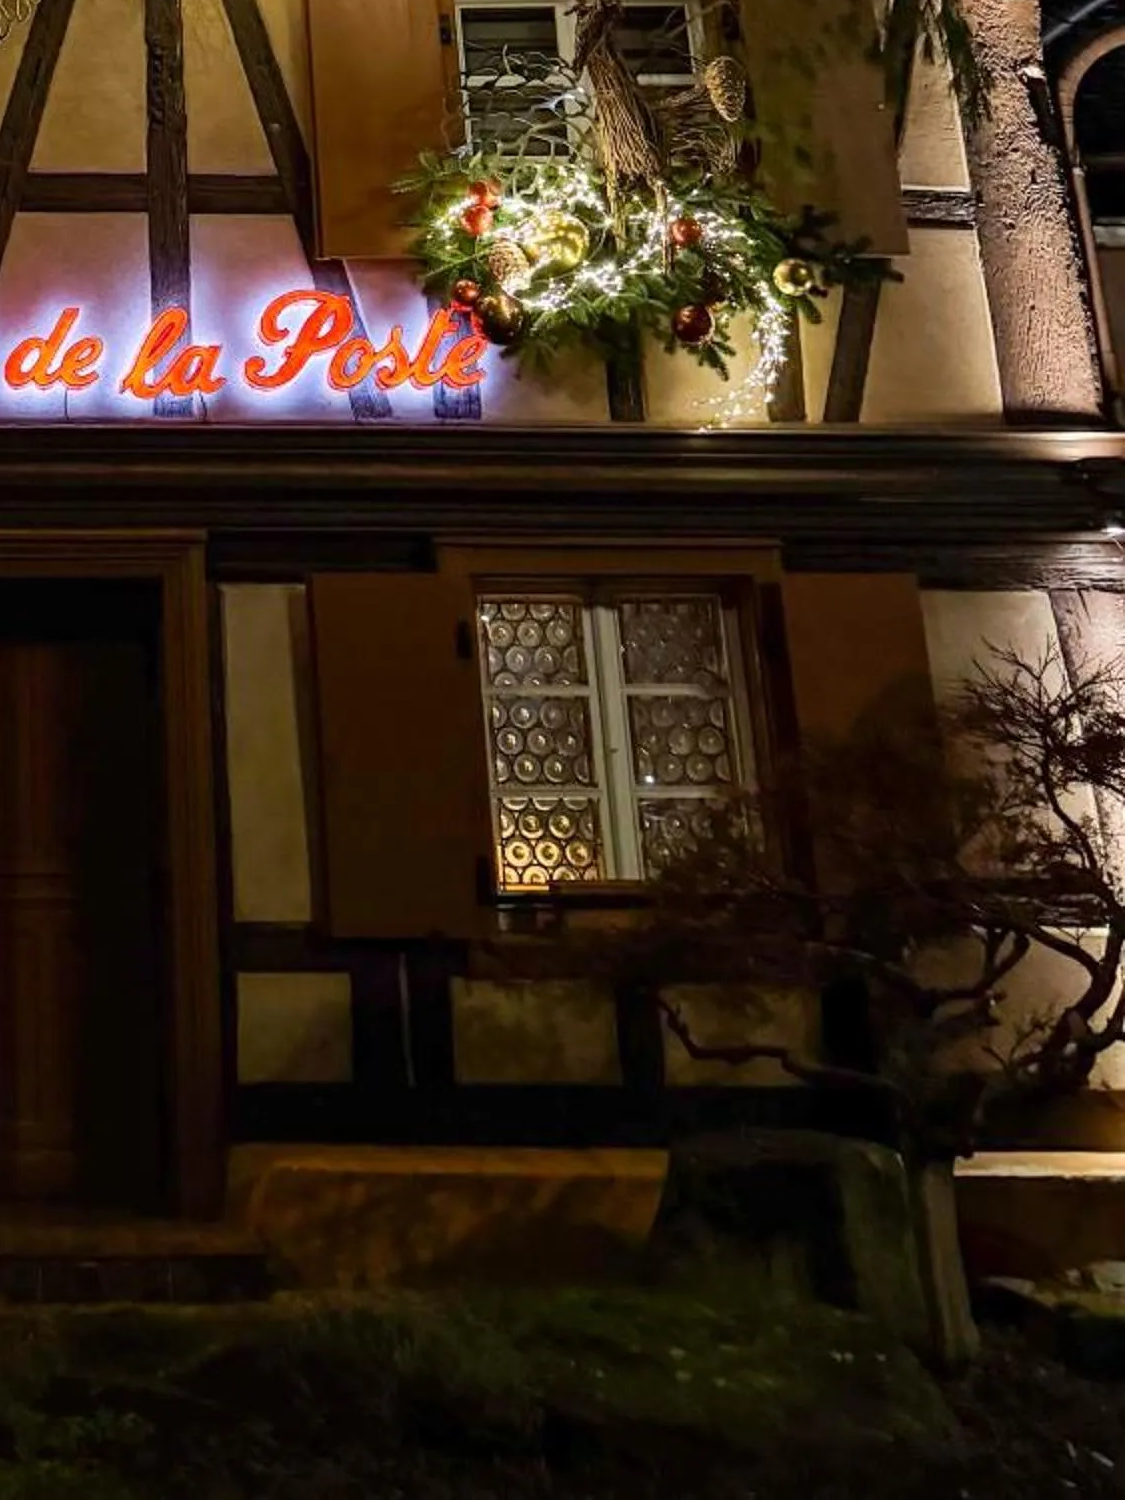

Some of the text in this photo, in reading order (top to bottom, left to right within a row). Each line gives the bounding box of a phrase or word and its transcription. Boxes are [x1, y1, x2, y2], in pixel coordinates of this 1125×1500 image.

[4, 307, 104, 390] de
[120, 305, 227, 398] la
[243, 289, 488, 390] Poste
